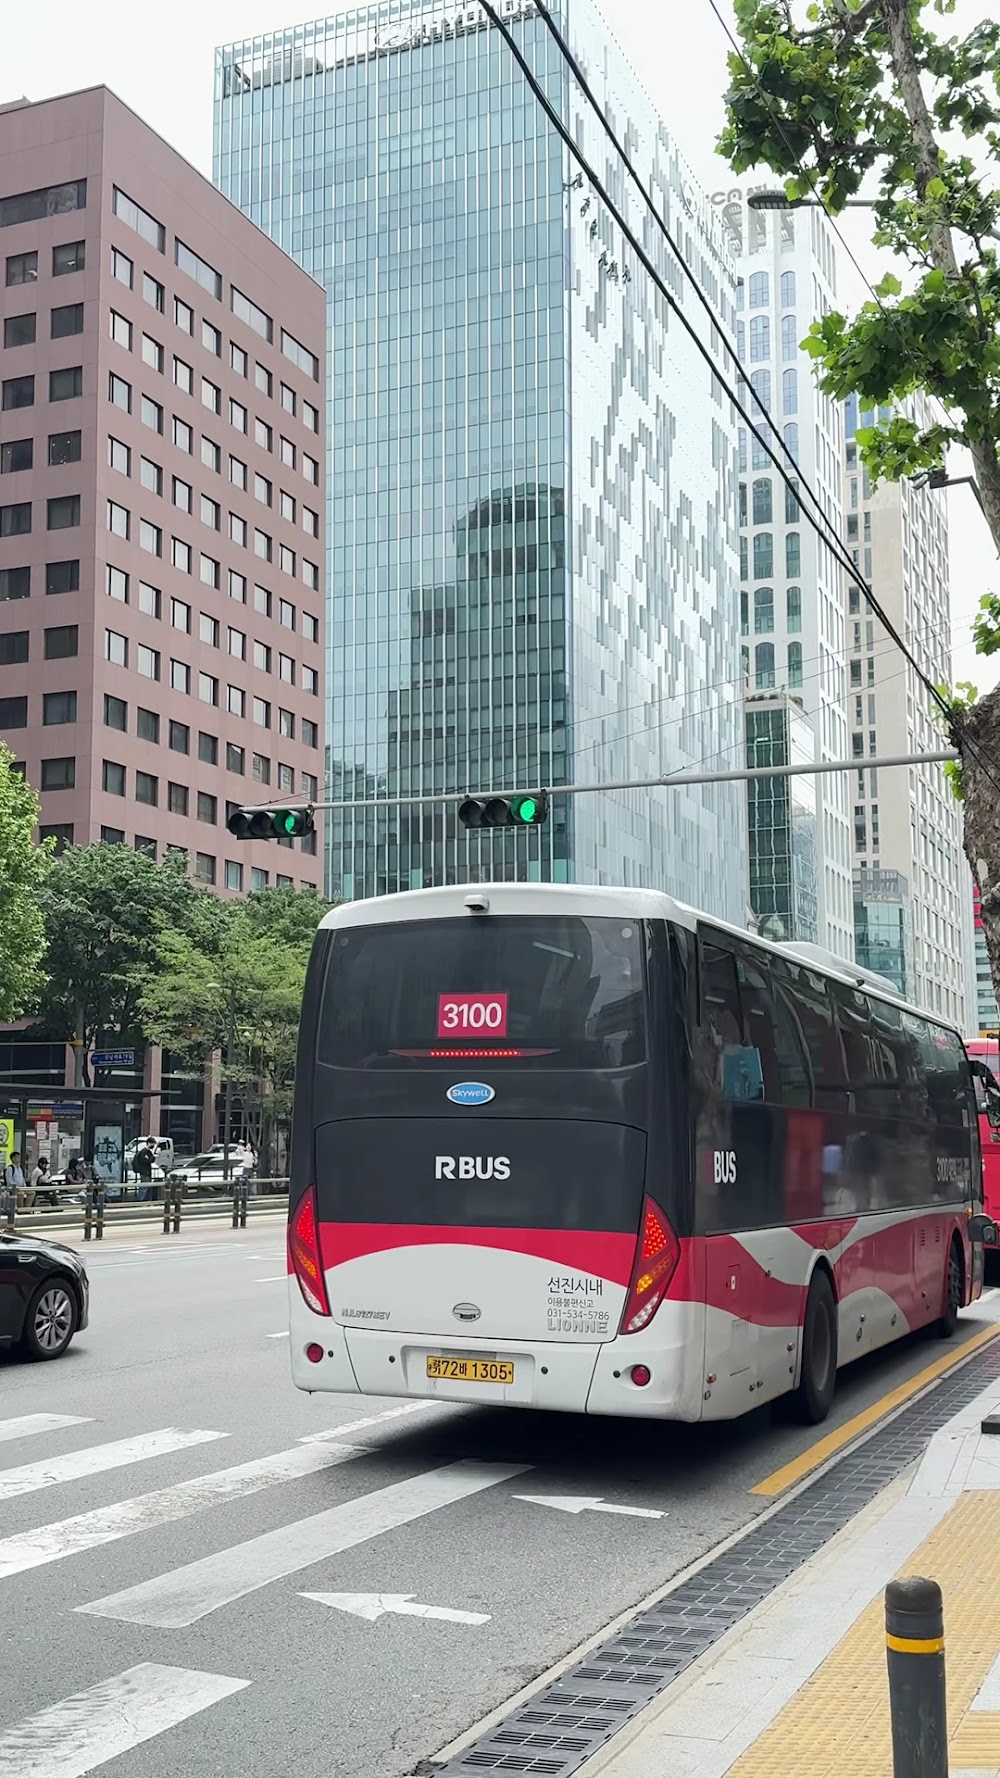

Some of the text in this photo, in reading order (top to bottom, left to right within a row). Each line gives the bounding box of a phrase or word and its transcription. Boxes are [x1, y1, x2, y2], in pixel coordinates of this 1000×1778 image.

[442, 1002, 502, 1028] 3100
[452, 1088, 488, 1098] Skywell
[547, 1277, 603, 1296] 선진시내
[547, 1308, 610, 1321] 031-534-5786
[472, 1362, 508, 1380] 1305
